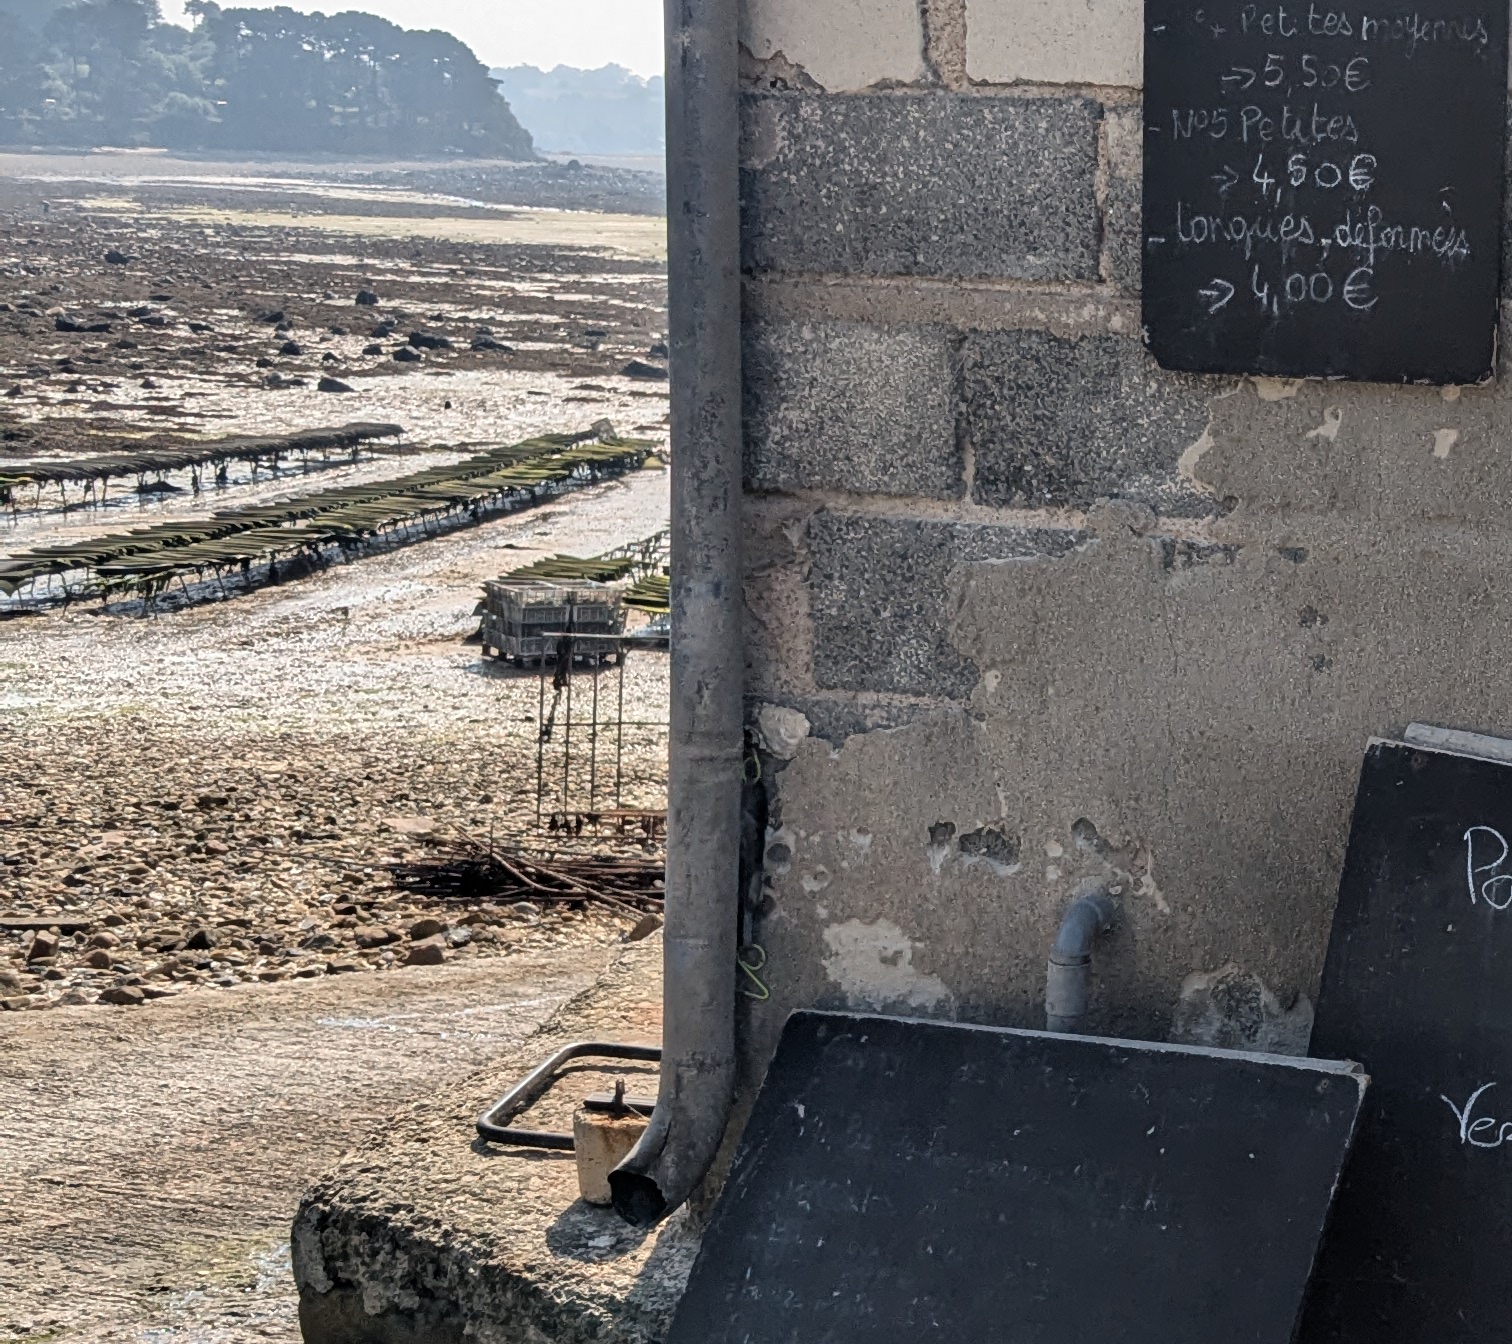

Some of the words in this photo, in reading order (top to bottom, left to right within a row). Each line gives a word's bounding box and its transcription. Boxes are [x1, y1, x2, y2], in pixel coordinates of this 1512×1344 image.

[1264, 53, 1370, 97] 5,50€
[1240, 104, 1359, 145] Petites
[1252, 263, 1379, 316] 4,00€
